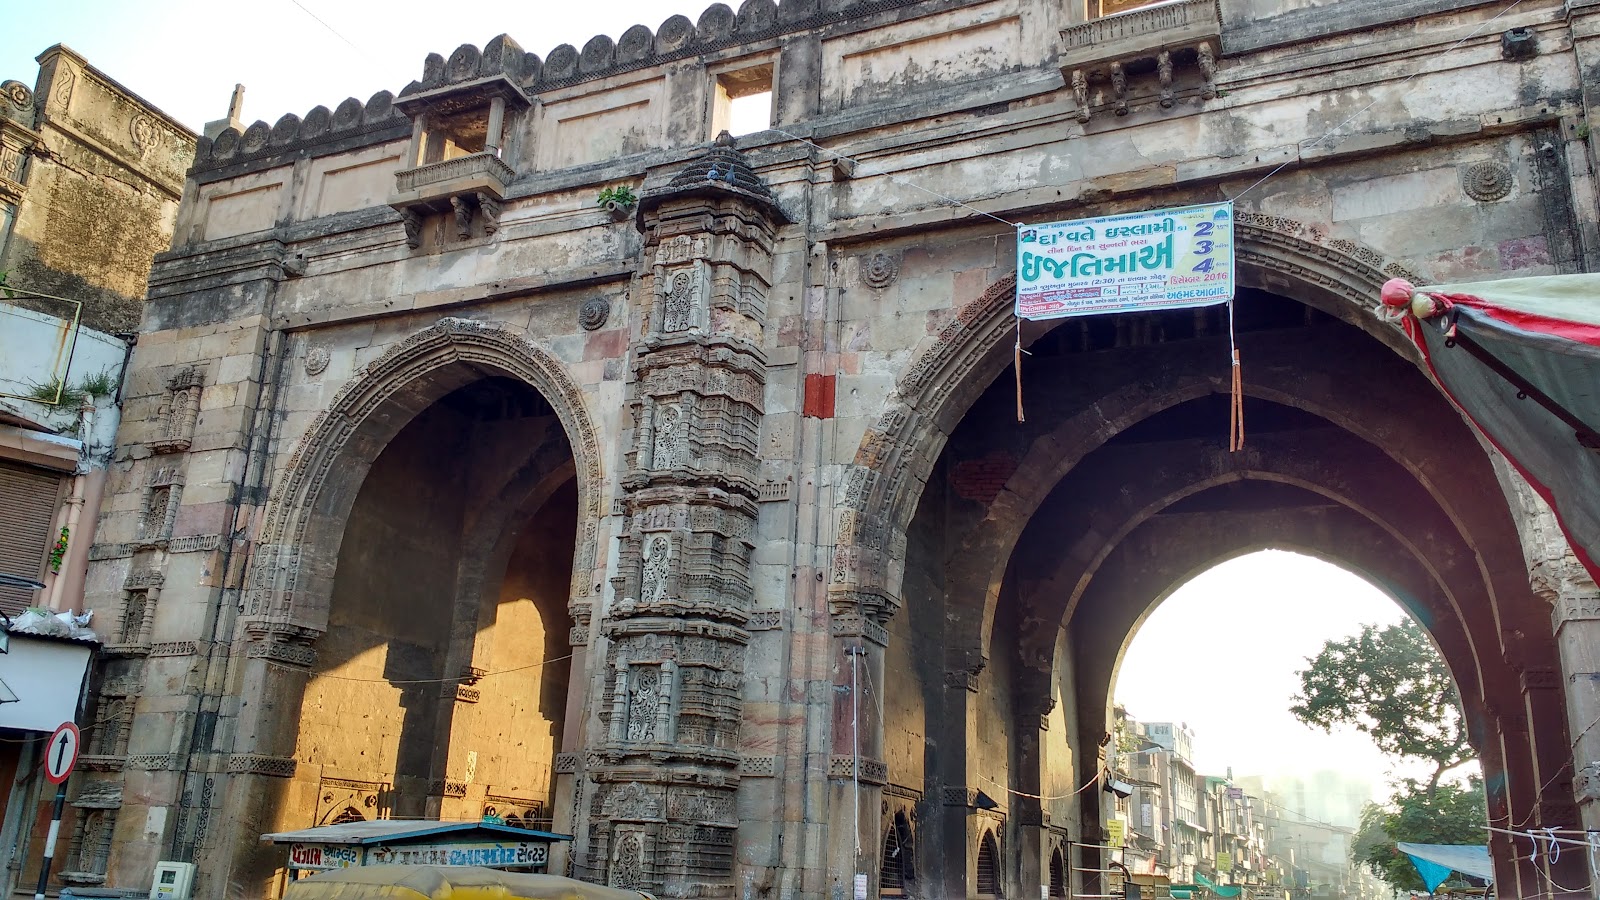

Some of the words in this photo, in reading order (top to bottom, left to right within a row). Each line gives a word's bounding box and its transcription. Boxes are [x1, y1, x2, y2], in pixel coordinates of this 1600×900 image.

[1193, 221, 1215, 237] 2
[1047, 246, 1064, 254] તીન
[1193, 240, 1214, 255] 3
[1192, 257, 1215, 273] 4
[1203, 272, 1228, 282] 2016
